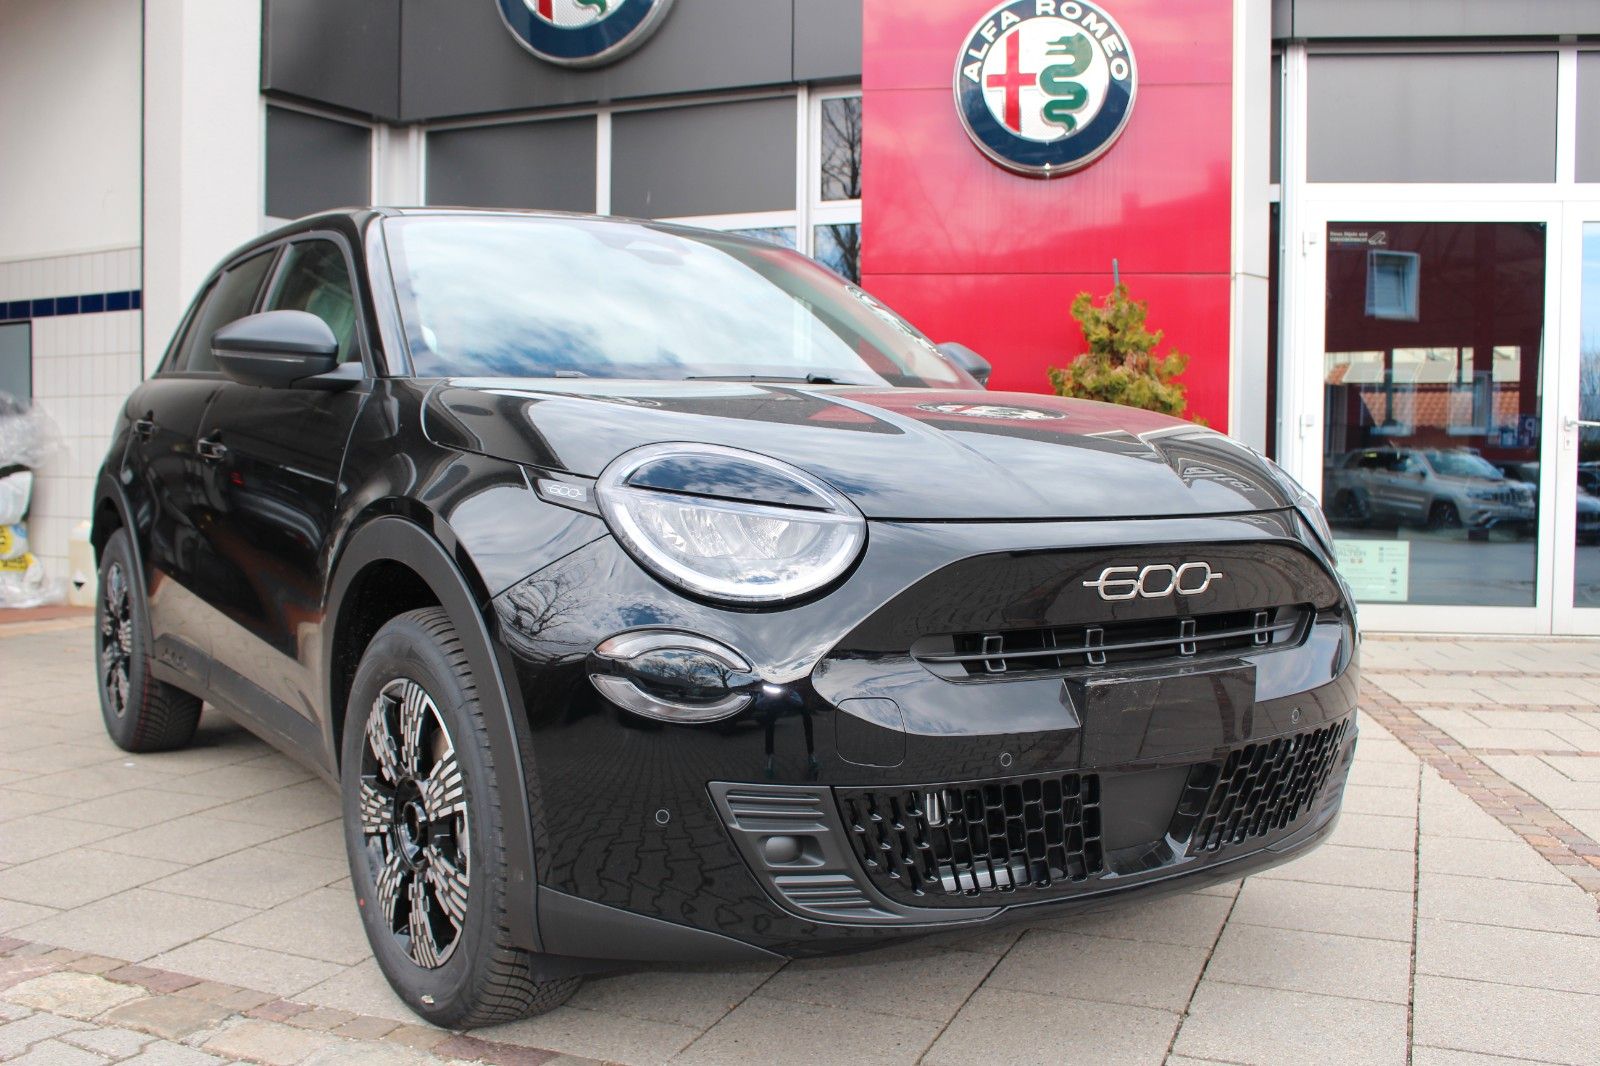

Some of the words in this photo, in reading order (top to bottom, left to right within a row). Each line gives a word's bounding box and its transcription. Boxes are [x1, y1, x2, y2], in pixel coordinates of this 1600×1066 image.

[963, 11, 1021, 83] ALFA
[1035, 0, 1129, 81] ROMEO
[549, 484, 580, 498] 600
[1093, 561, 1213, 601] 600
